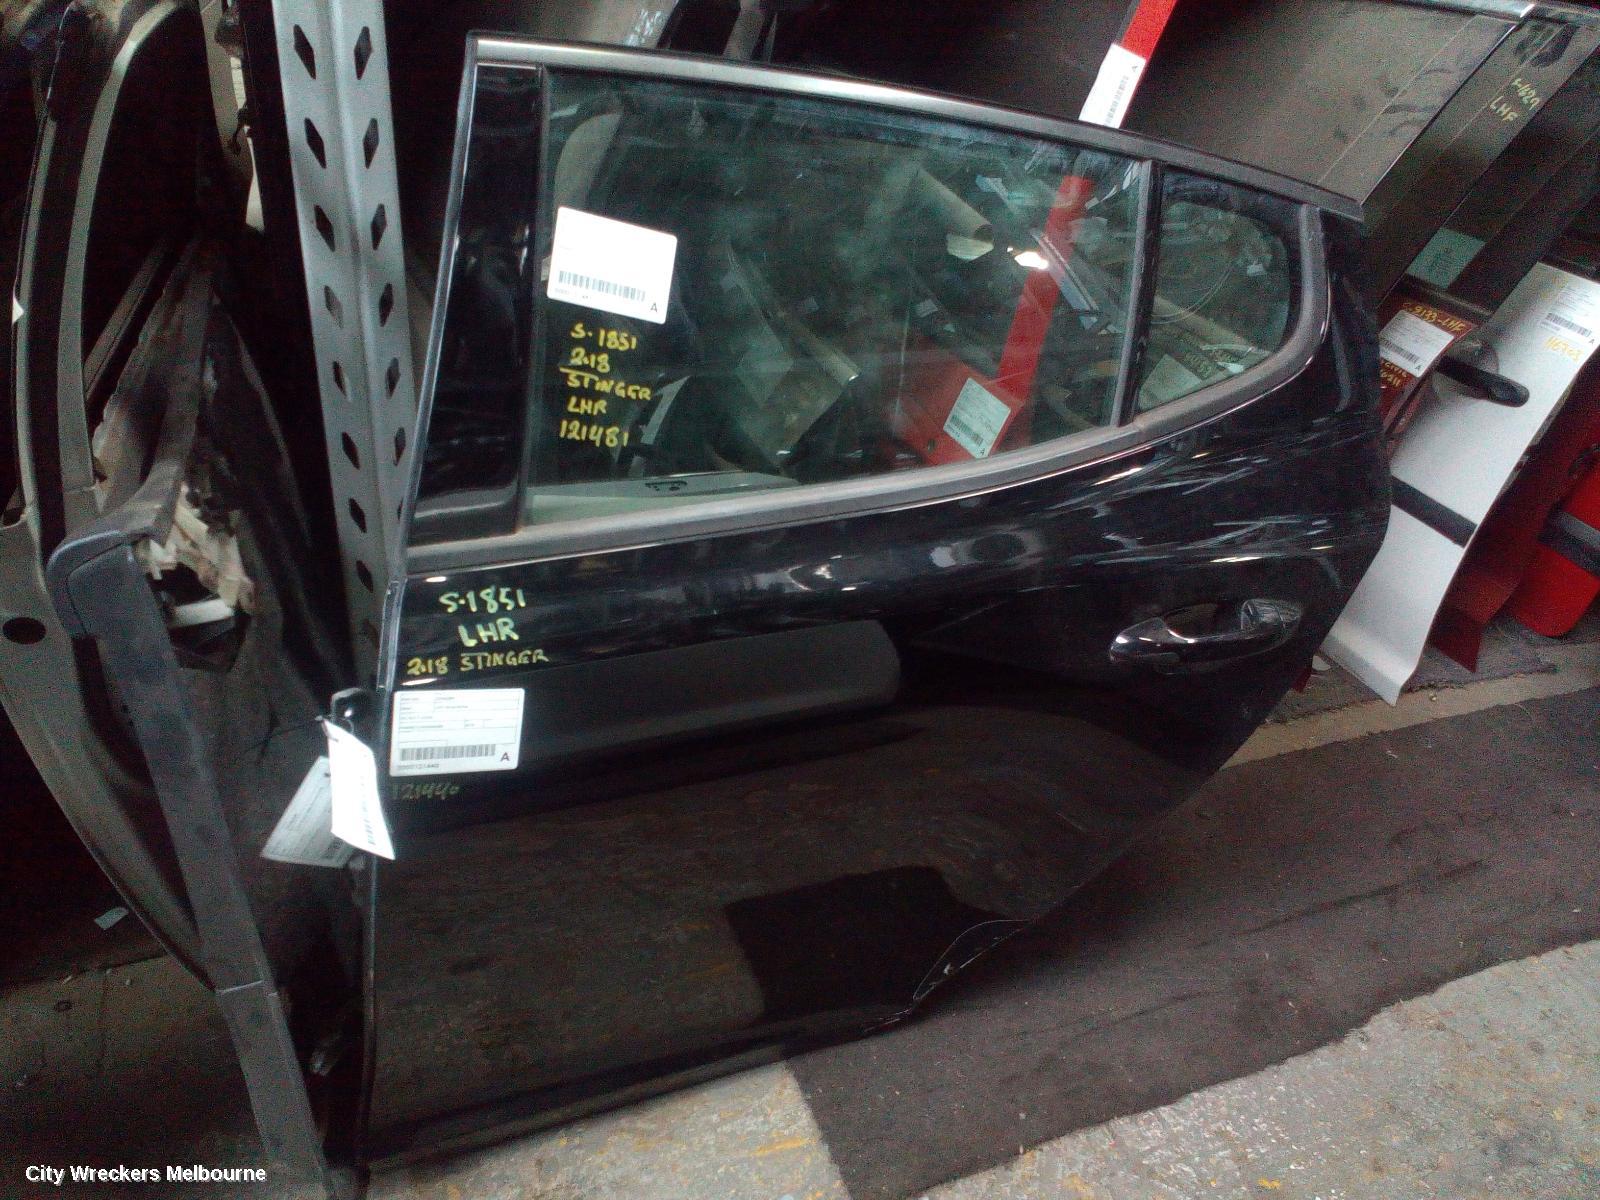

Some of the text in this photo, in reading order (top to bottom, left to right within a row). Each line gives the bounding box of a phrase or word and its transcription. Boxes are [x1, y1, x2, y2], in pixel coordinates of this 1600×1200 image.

[650, 302, 658, 313] A
[560, 366, 651, 401] STINGER
[567, 395, 608, 416] LHR
[559, 419, 629, 448] 121481
[457, 617, 520, 648] LHR
[459, 648, 550, 672] STINGER
[500, 751, 511, 762] A
